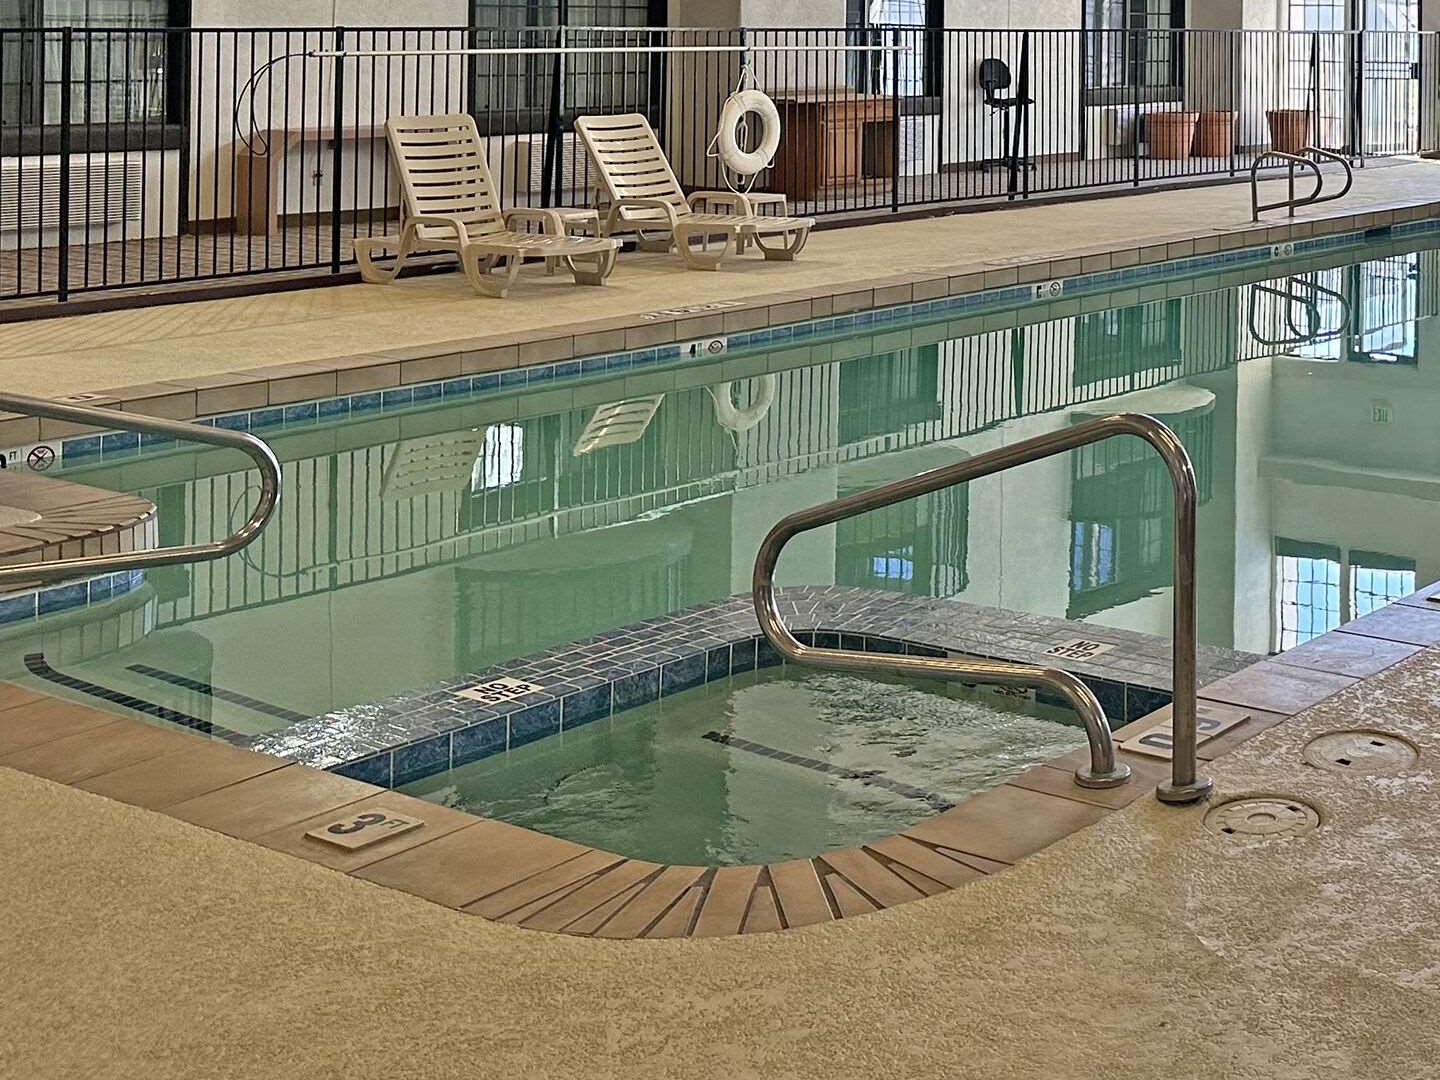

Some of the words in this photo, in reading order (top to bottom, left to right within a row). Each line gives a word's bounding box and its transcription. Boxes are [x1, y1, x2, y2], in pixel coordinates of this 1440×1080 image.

[1070, 640, 1101, 651] NO
[1047, 646, 1095, 659] STEP
[473, 683, 510, 694] NO
[480, 684, 532, 702] STEP
[327, 813, 386, 835] 3
